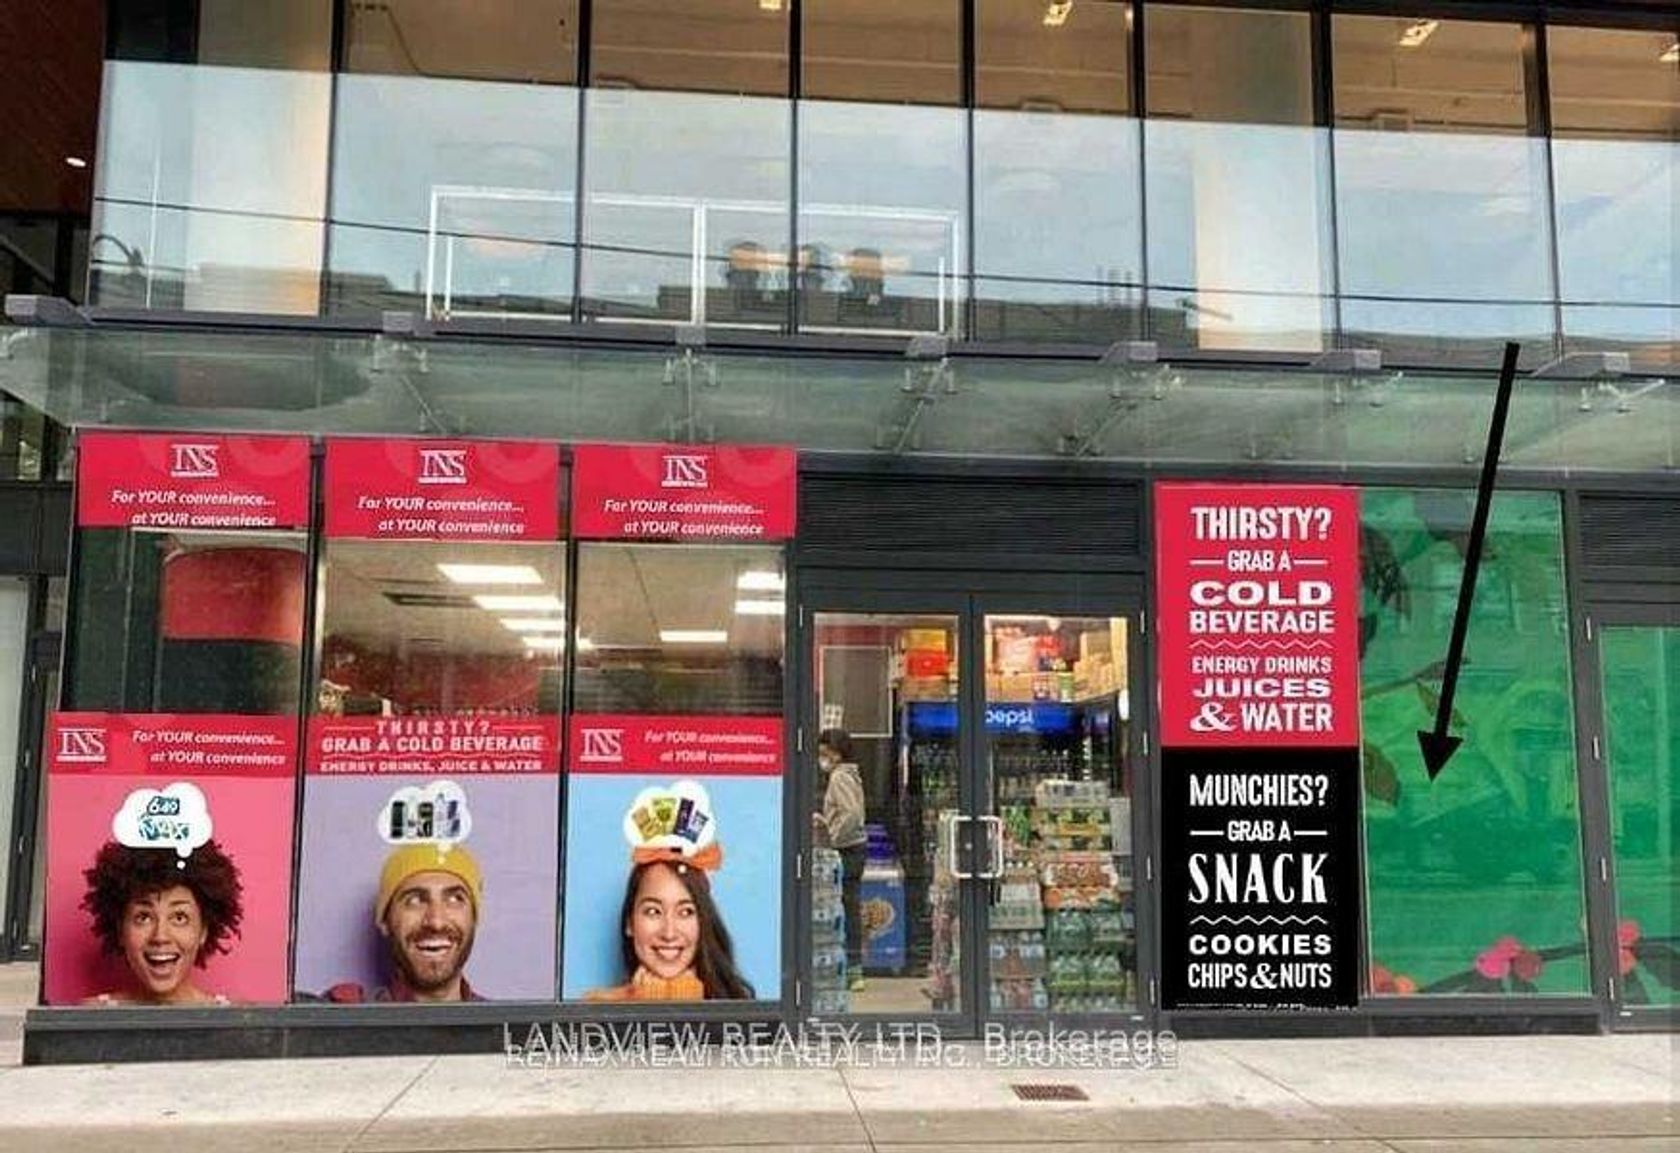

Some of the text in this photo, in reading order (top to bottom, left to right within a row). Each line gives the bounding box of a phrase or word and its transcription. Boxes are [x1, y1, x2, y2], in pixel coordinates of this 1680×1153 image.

[173, 444, 219, 472] INS
[419, 450, 467, 477] INS
[662, 456, 708, 481] INS
[112, 489, 135, 503] For
[138, 490, 177, 503] YOUR
[358, 496, 380, 509] For
[384, 497, 425, 510] YOUR
[604, 500, 627, 512] For
[629, 500, 668, 513] YOUR
[132, 513, 276, 526] at YOUR convenience
[378, 519, 524, 533] at YOUR convenience
[624, 521, 764, 535] at YOUR convenience
[1190, 505, 1332, 540] THIRSTY?
[1227, 550, 1292, 571] GRAB A
[1190, 581, 1332, 606] COLD
[1190, 610, 1335, 634] BEVERAGE
[1192, 656, 1332, 673] ENERGY DRINKS
[1193, 678, 1331, 697] JUICES
[1189, 701, 1333, 732] & WATER
[133, 730, 155, 743] For
[157, 730, 193, 744] YOUR
[375, 720, 490, 735] THIRSTY?
[645, 730, 664, 743] For
[666, 731, 698, 743] YOUR
[59, 729, 106, 754] INS
[321, 736, 543, 752] GRAB A COLD BEVERAGE
[582, 729, 624, 755] INS
[150, 751, 286, 765] at YOUR convenience
[320, 760, 542, 773] ENERGY DRINKS, JUICE & WATER
[675, 751, 707, 763] YOUR
[708, 752, 776, 764] convenience
[1189, 773, 1329, 806] MUNCHIES?
[1227, 820, 1292, 842] GRAB A
[1188, 853, 1328, 903] SNACK
[1189, 934, 1332, 955] COOKIES
[1188, 963, 1247, 989] CHIPS
[1280, 963, 1332, 989] NUTS
